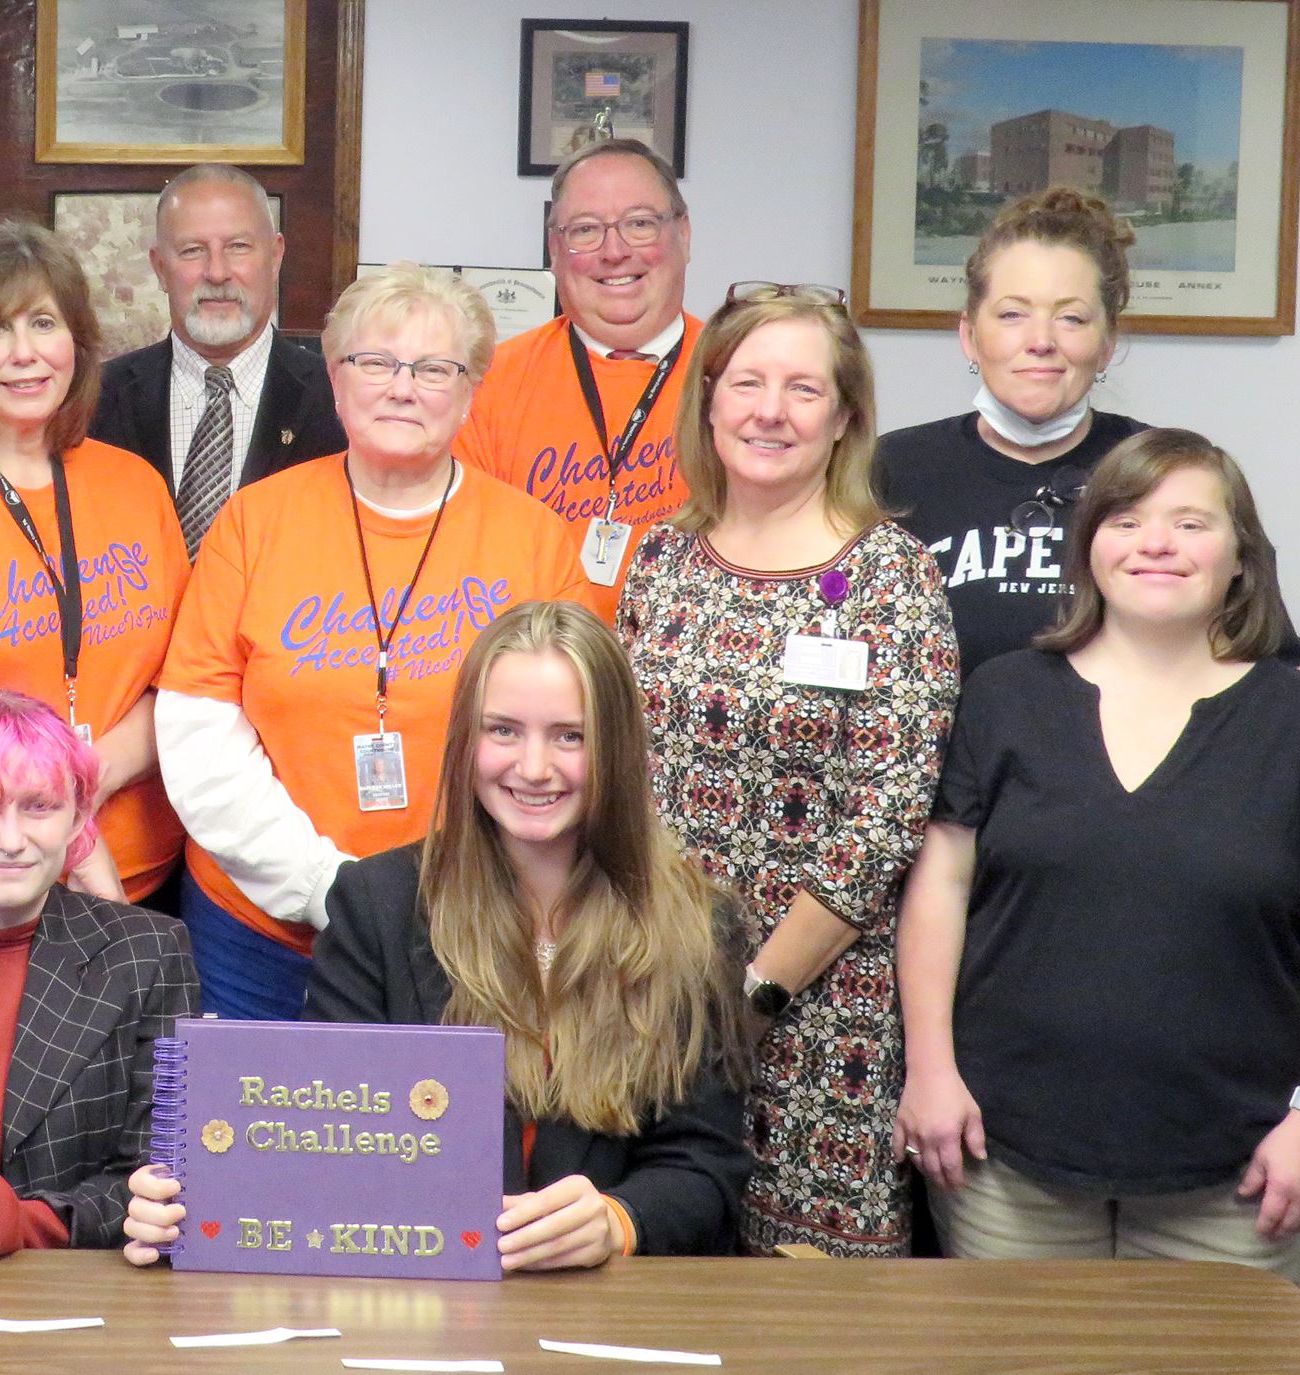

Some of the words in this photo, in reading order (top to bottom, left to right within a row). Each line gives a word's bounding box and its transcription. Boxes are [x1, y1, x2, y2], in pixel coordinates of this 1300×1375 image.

[998, 582, 1031, 593] NEW
[1037, 583, 1075, 595] JERS
[83, 604, 169, 645] NiceIsFree
[280, 576, 512, 651] Challenge
[238, 1076, 392, 1114] Rachels
[245, 1121, 442, 1163] Challenge
[236, 1217, 292, 1251] BE
[329, 1223, 445, 1256] KIND
